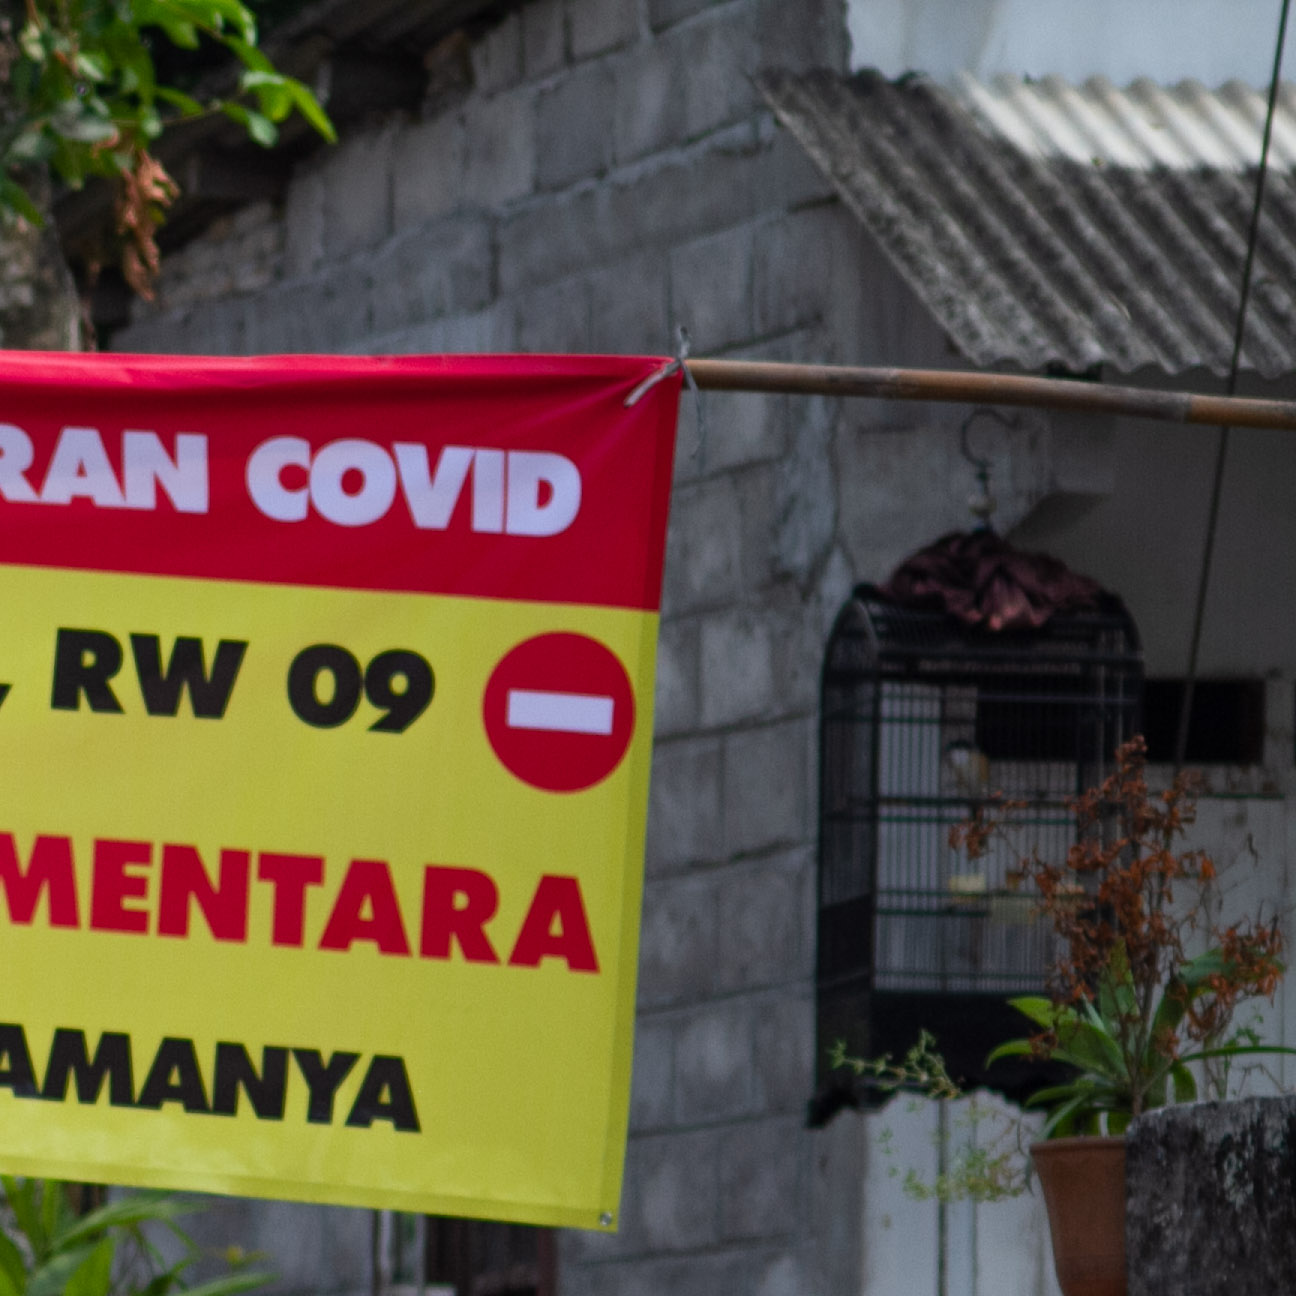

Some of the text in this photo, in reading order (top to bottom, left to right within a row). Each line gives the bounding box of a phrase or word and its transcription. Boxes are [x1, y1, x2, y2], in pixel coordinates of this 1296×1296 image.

[246, 437, 582, 536] COVID
[50, 627, 248, 719] RW
[286, 643, 436, 734] 09
